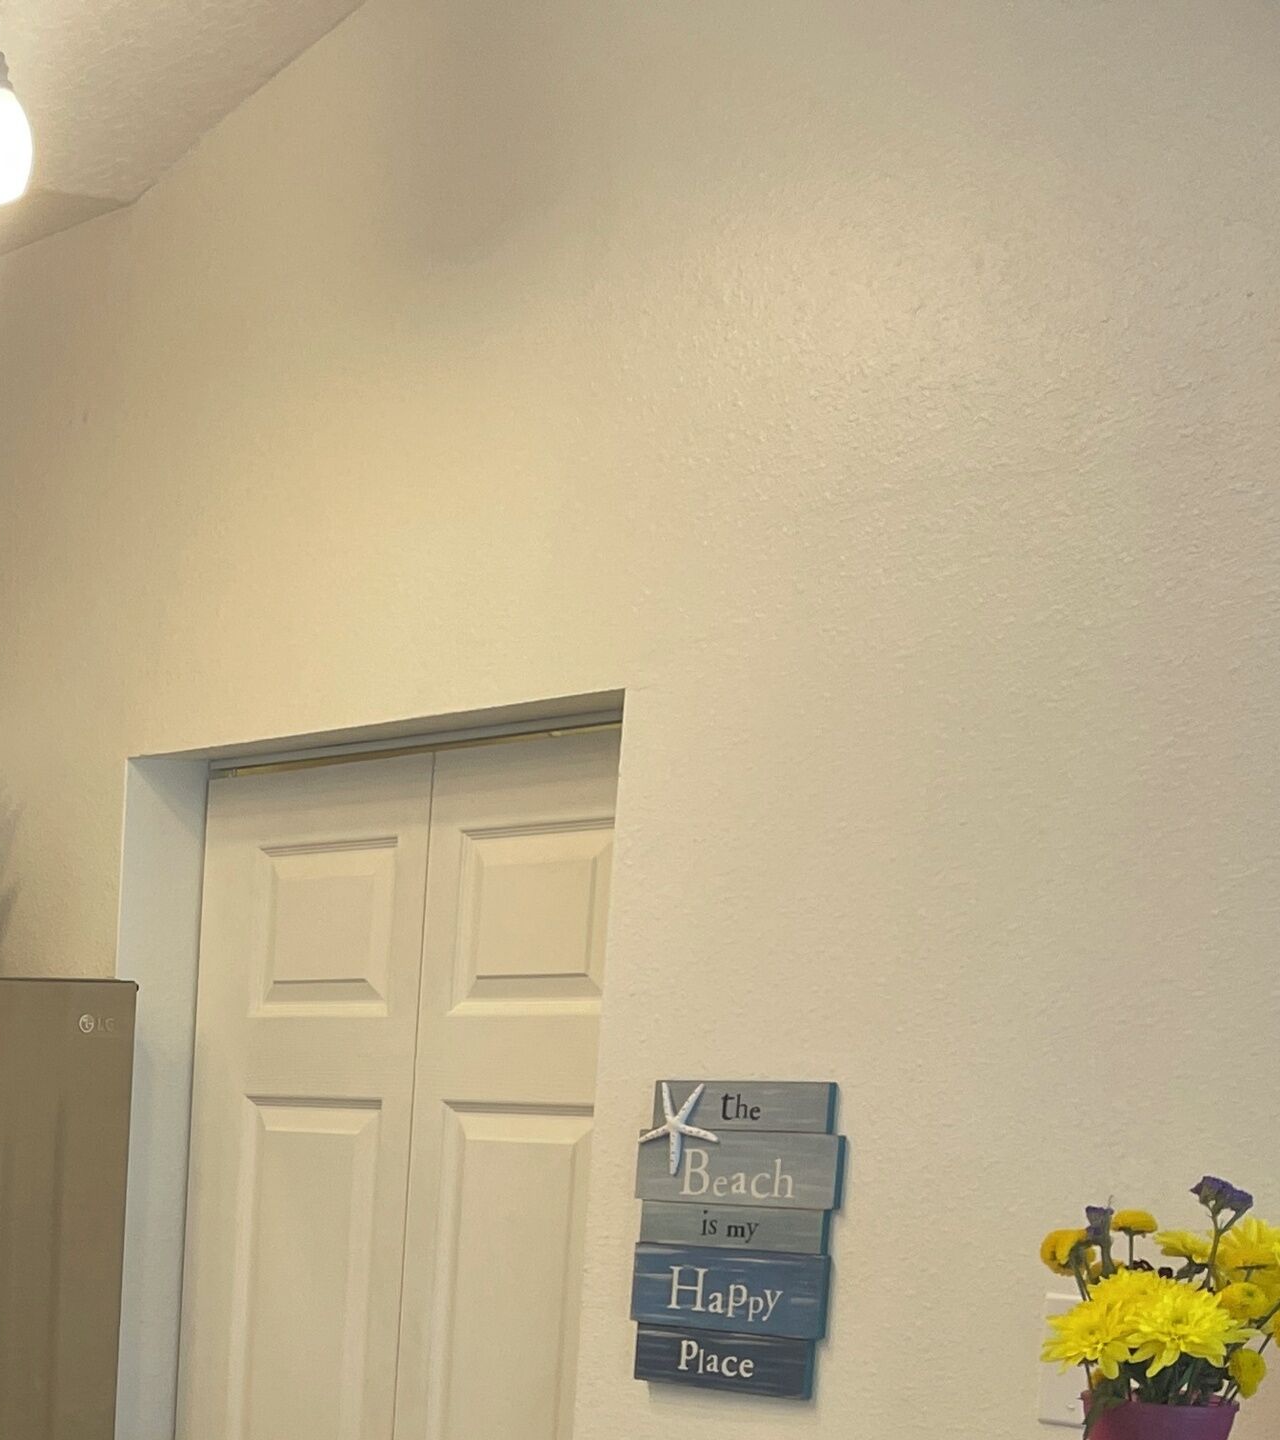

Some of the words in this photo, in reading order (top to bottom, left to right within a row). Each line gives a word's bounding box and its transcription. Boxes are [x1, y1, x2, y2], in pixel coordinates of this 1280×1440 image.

[721, 1093, 761, 1121] the
[679, 1148, 796, 1200] Beach
[700, 1210, 718, 1237] is
[726, 1221, 759, 1244] my
[666, 1265, 784, 1322] Happy
[677, 1339, 755, 1378] Place
